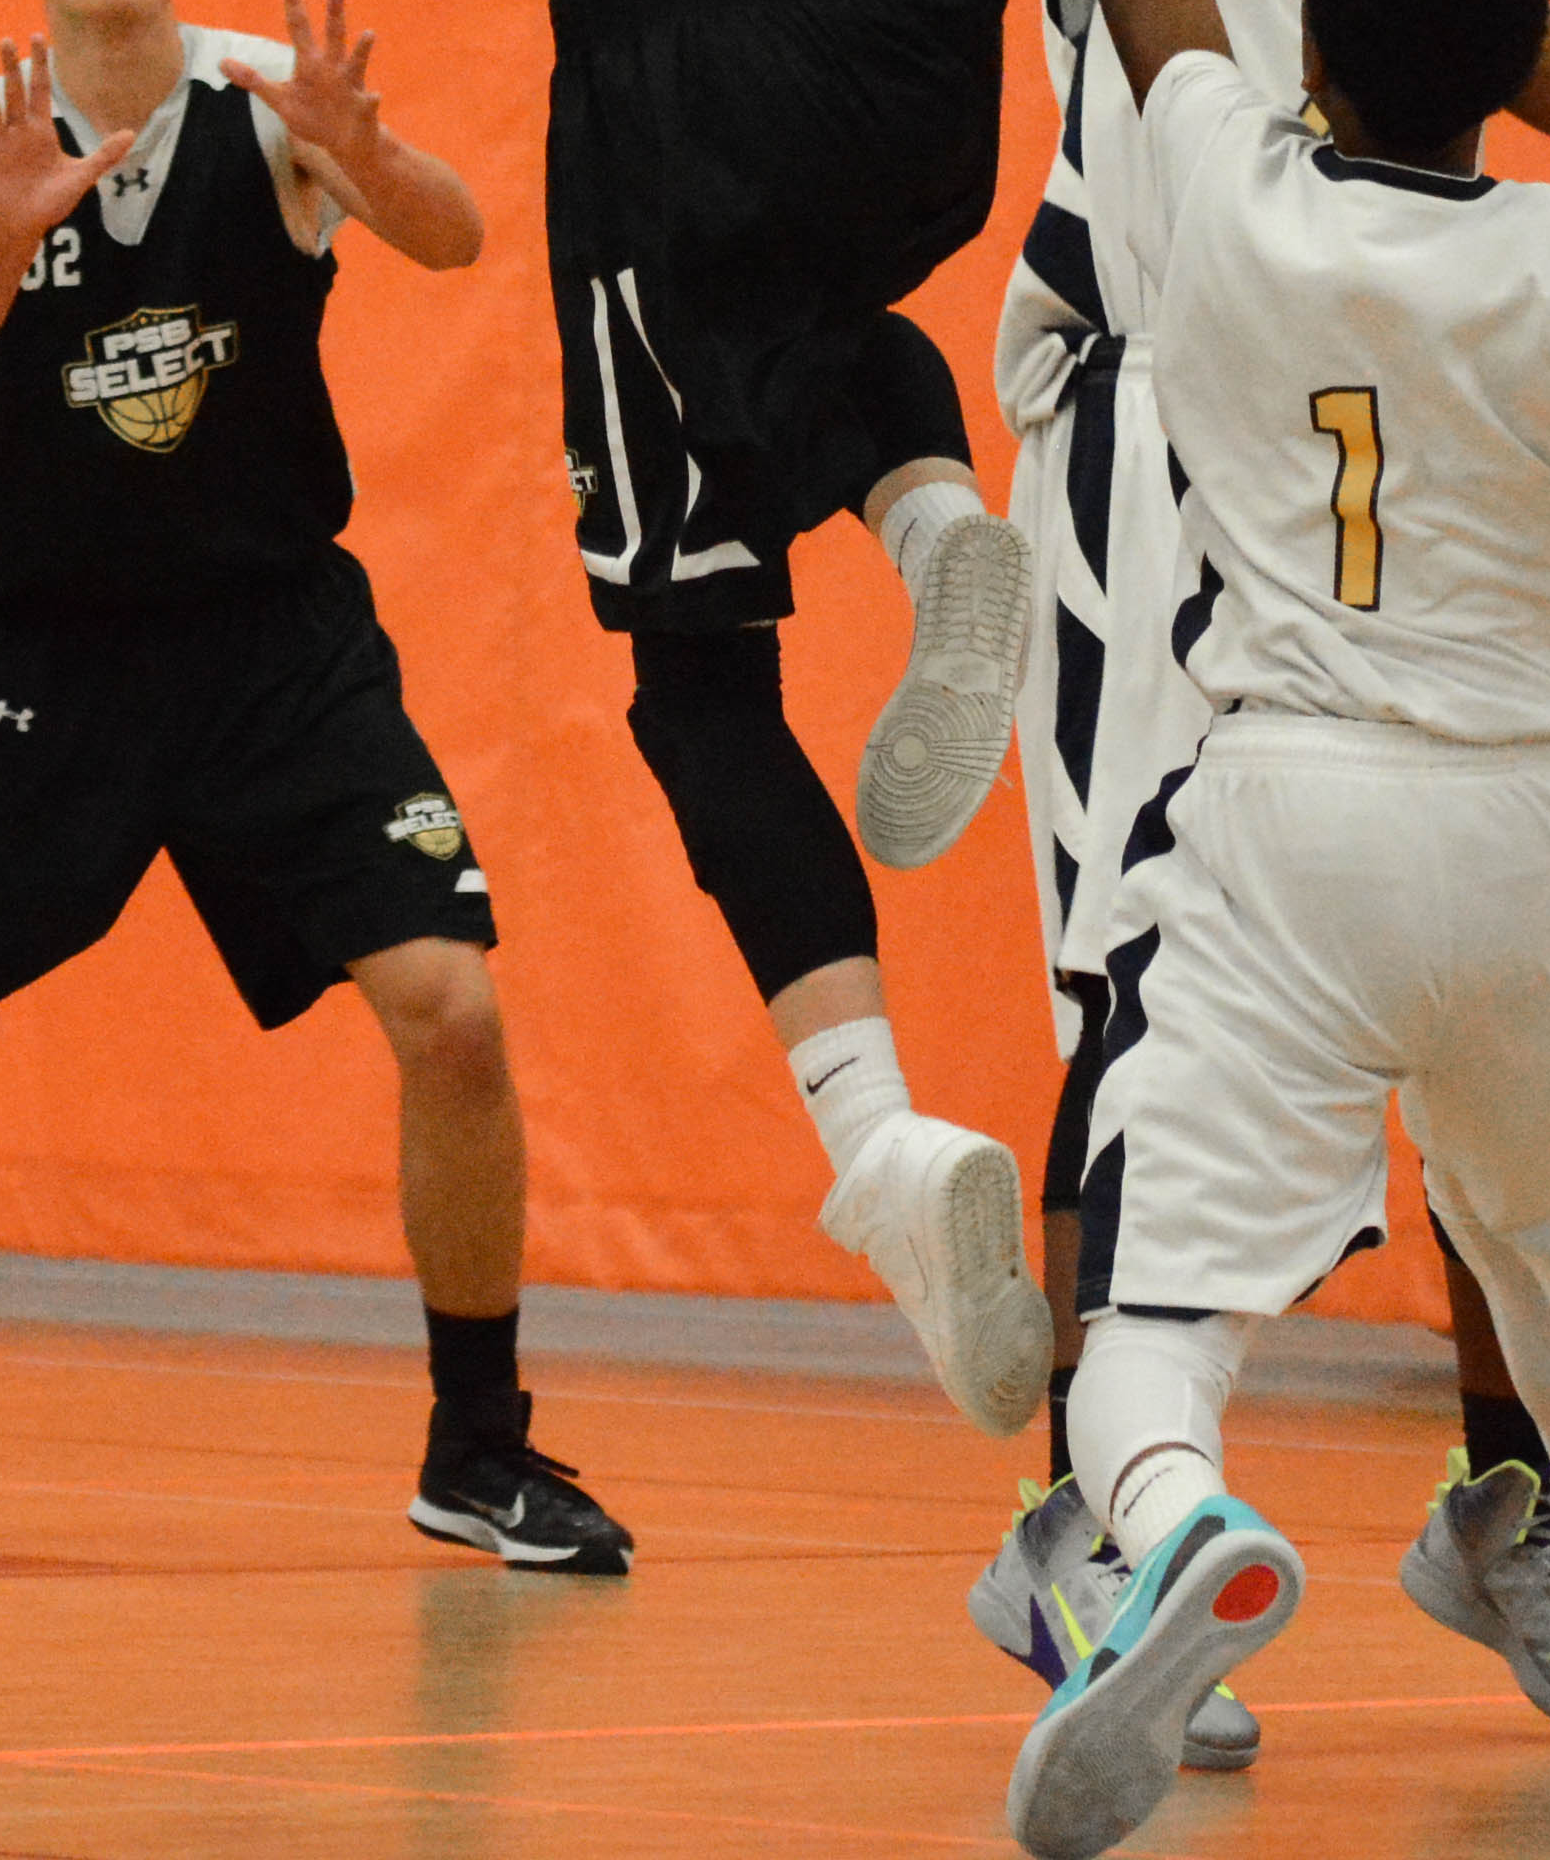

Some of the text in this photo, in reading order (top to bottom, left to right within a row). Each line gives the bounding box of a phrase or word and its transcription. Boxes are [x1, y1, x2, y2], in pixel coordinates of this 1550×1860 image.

[68, 327, 233, 403] SELECT
[102, 317, 193, 361] PSB
[1308, 385, 1384, 612] 1
